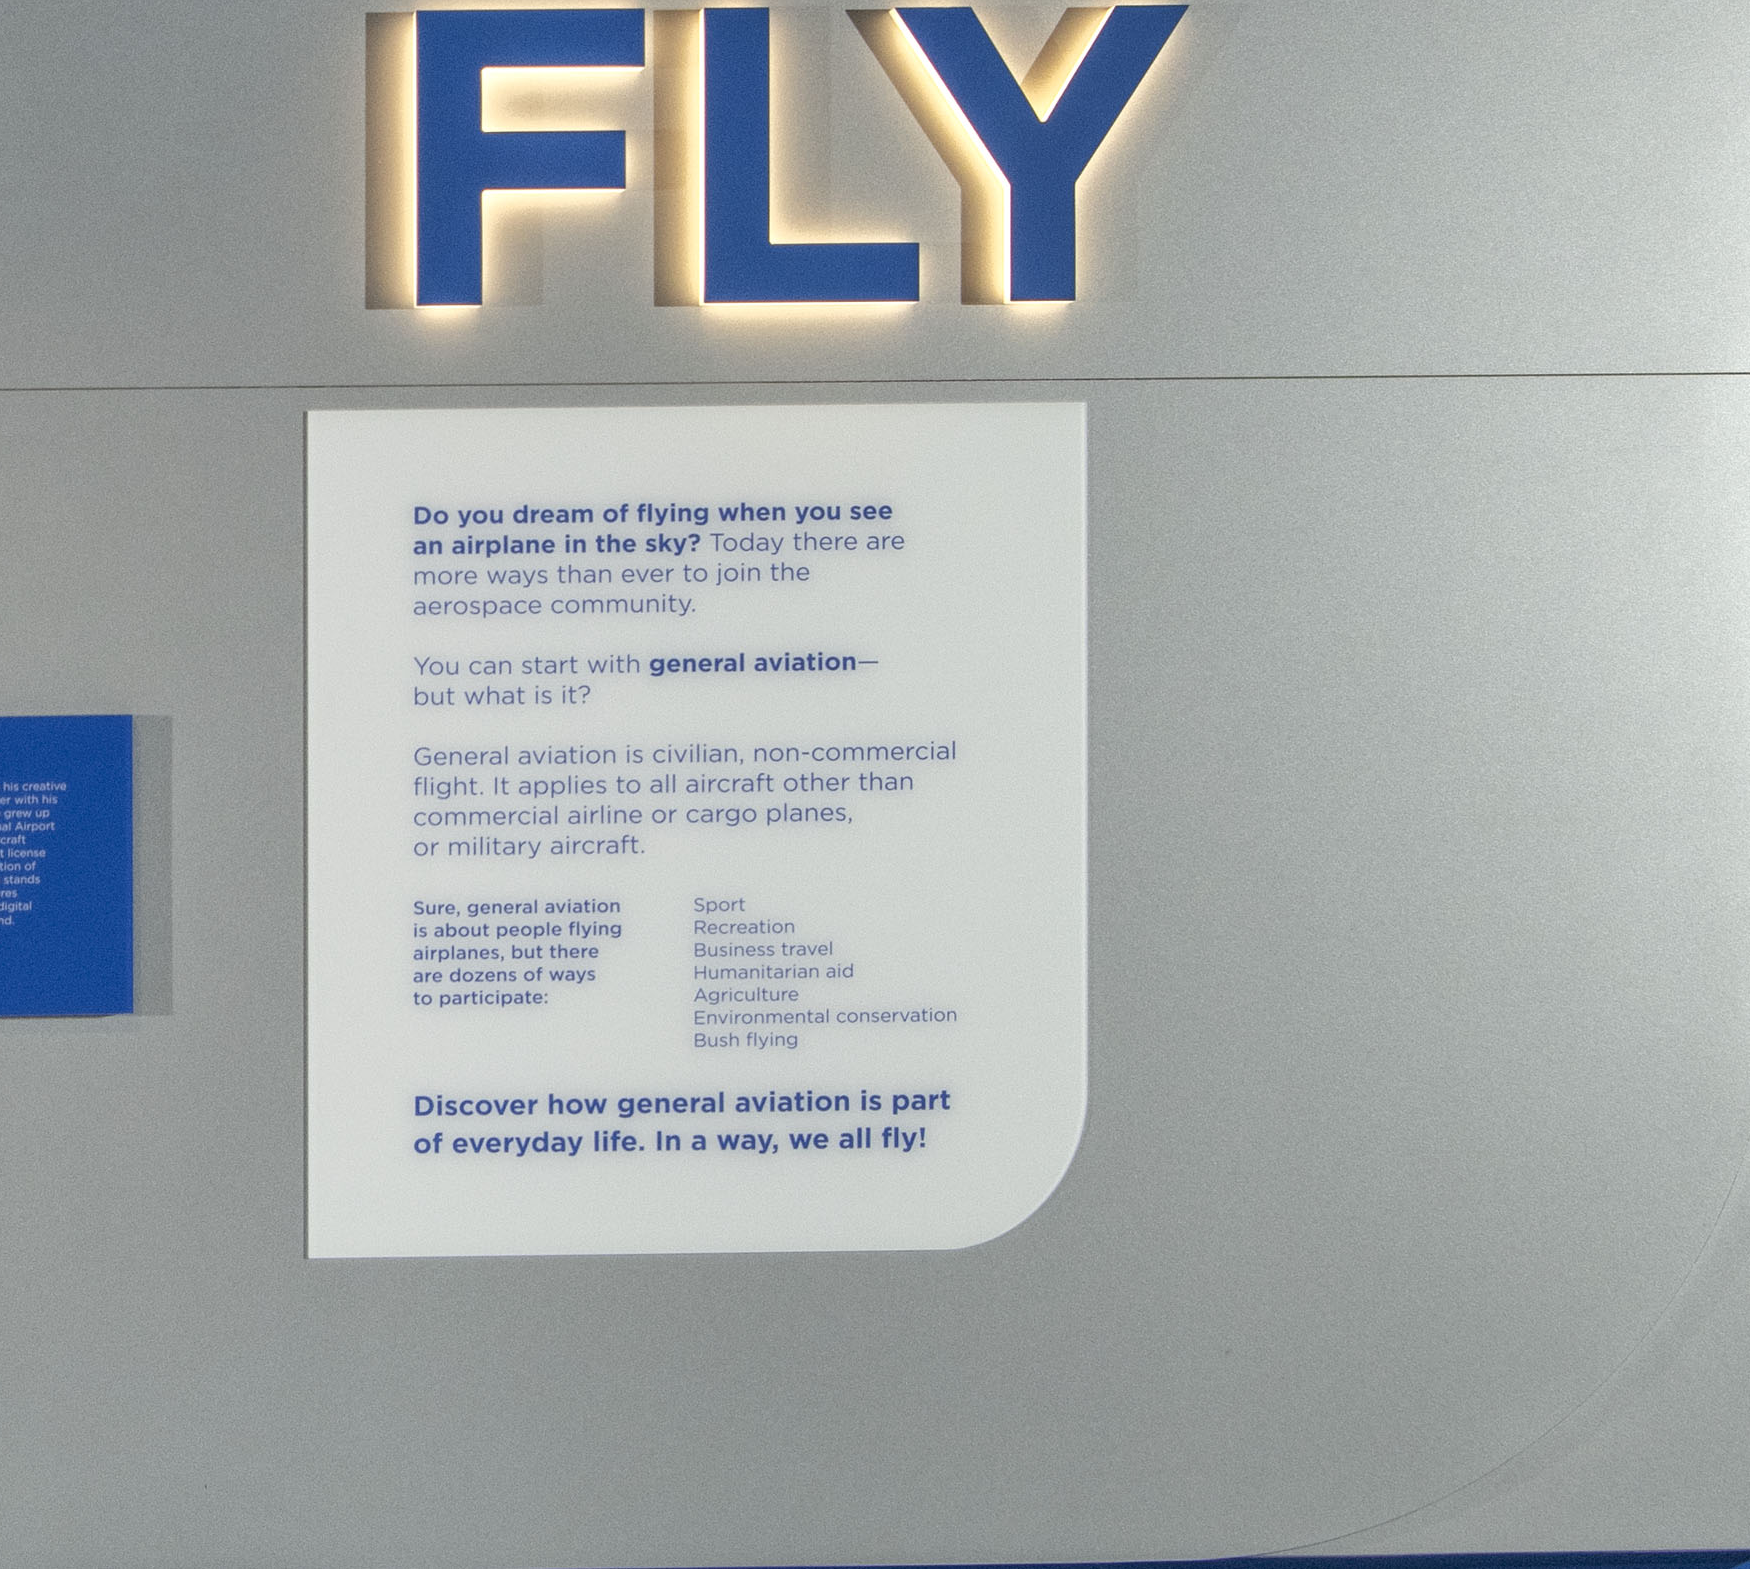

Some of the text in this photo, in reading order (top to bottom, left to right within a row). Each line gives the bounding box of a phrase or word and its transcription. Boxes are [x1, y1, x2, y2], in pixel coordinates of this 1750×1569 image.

[416, 5, 1189, 305] FLY
[414, 502, 892, 528] Do you dream of flying when you see
[413, 531, 904, 558] an airplane in the sky? Today there are
[414, 561, 810, 588] more ways than ever to join the
[413, 593, 695, 618] aerospace community.
[414, 657, 458, 675] You
[469, 660, 511, 674] can
[522, 656, 577, 674] start
[587, 654, 639, 673] with
[649, 652, 745, 676] general
[414, 684, 591, 706] but what is it?
[413, 741, 956, 766] General aviation is civilian, non-commercial
[2, 782, 19, 791] his
[21, 781, 66, 791] creative
[413, 771, 913, 800] flight. It applies to all aircraft other than
[3, 809, 32, 819] grew
[35, 809, 50, 818] up
[413, 802, 852, 827] commercial airline or cargo planes,
[7, 848, 46, 858] license
[413, 834, 644, 859] or military aircraft.
[3, 874, 40, 884] stands
[413, 898, 620, 917] Sure, general aviation
[693, 896, 745, 915] Sport
[413, 920, 622, 939] is about people flying
[693, 919, 795, 935] Recreation
[413, 943, 599, 962] airplanes, but there
[694, 941, 833, 957] Business travel
[413, 966, 596, 984] are dozens of ways
[694, 963, 854, 979] Humanitarian aid
[413, 989, 548, 1007] to participate:
[693, 986, 799, 1005] Agriculture
[694, 1007, 957, 1025] Environmental conservation
[694, 1030, 798, 1050] Bush flying
[414, 1089, 950, 1118] Discover how general aviation is part
[413, 1126, 925, 1157] of everyday life. In a way, we all fly!
